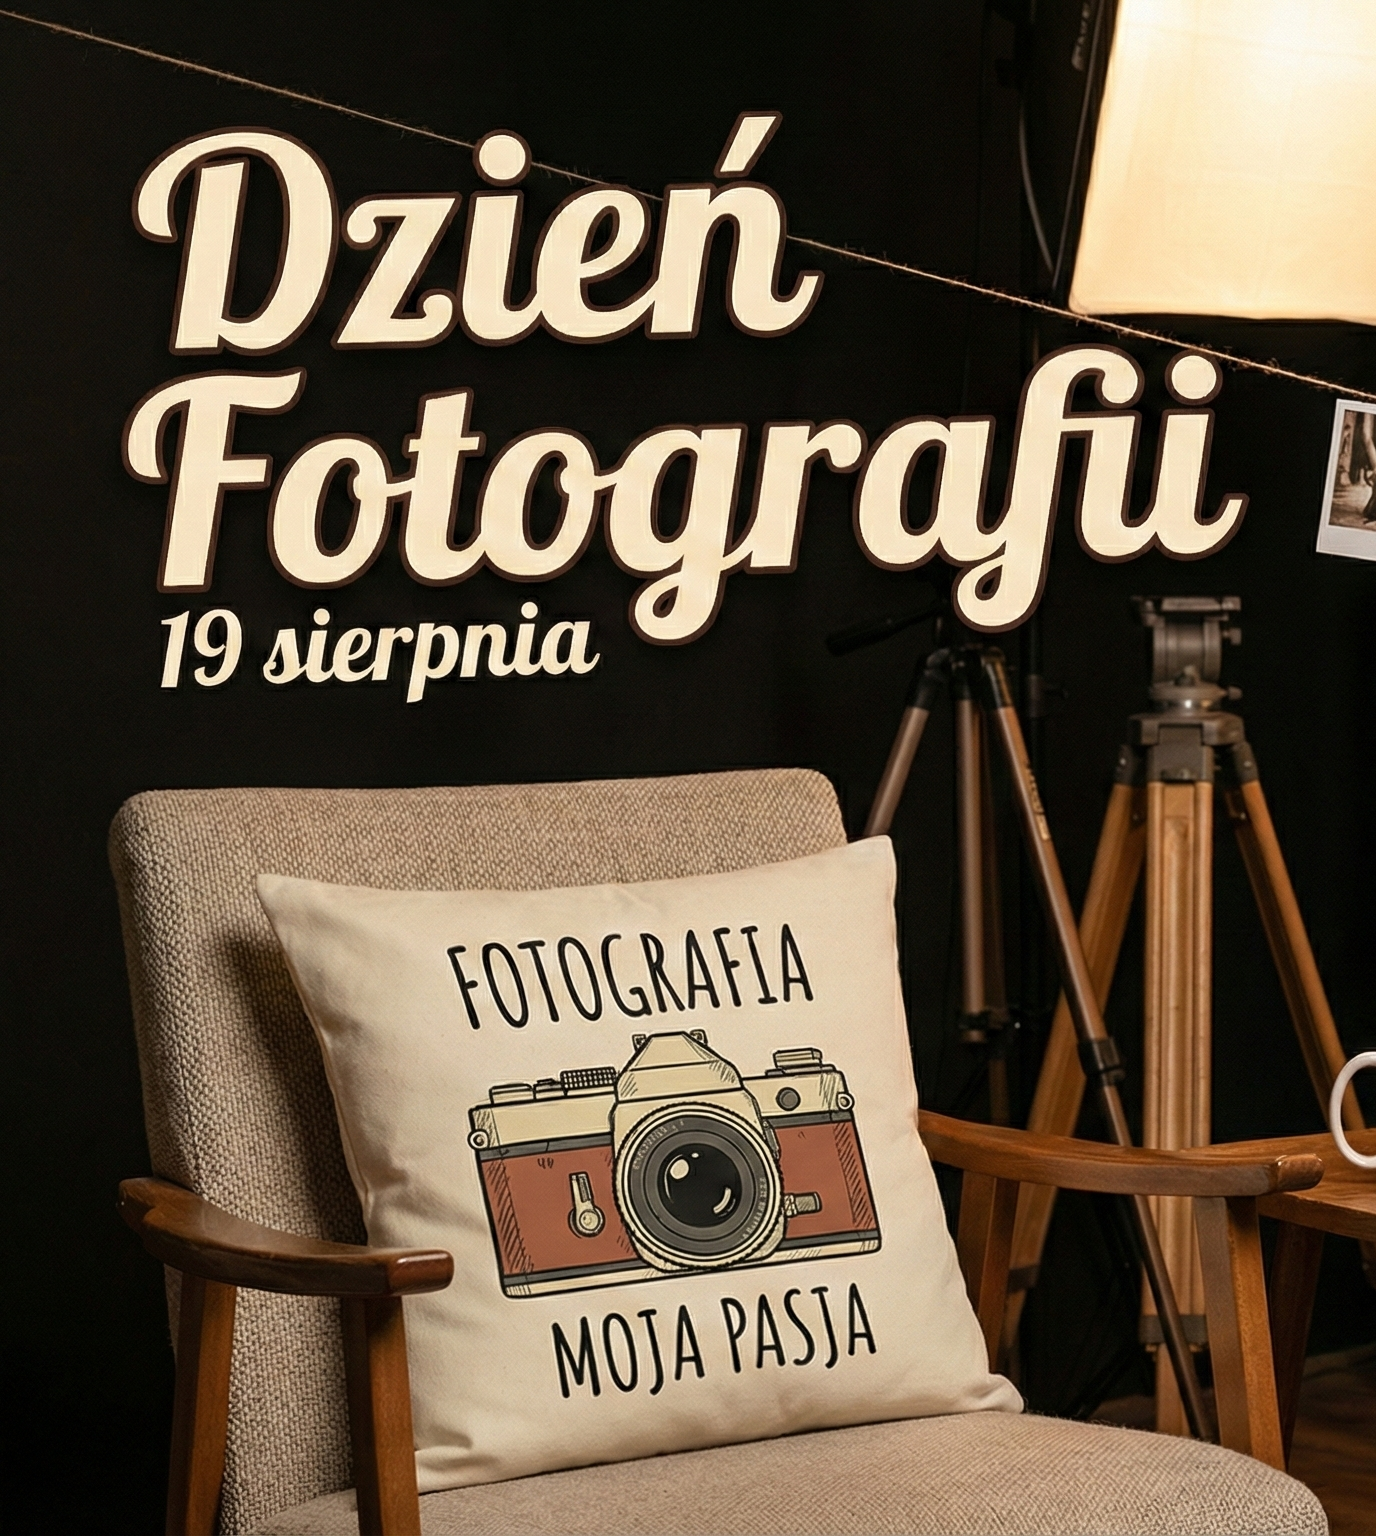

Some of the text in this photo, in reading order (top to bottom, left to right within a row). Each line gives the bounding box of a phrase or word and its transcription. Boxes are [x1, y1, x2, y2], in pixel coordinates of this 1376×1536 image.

[446, 922, 815, 1031] FOTOGRAFIA
[551, 1282, 878, 1400] MOJA PASJA
